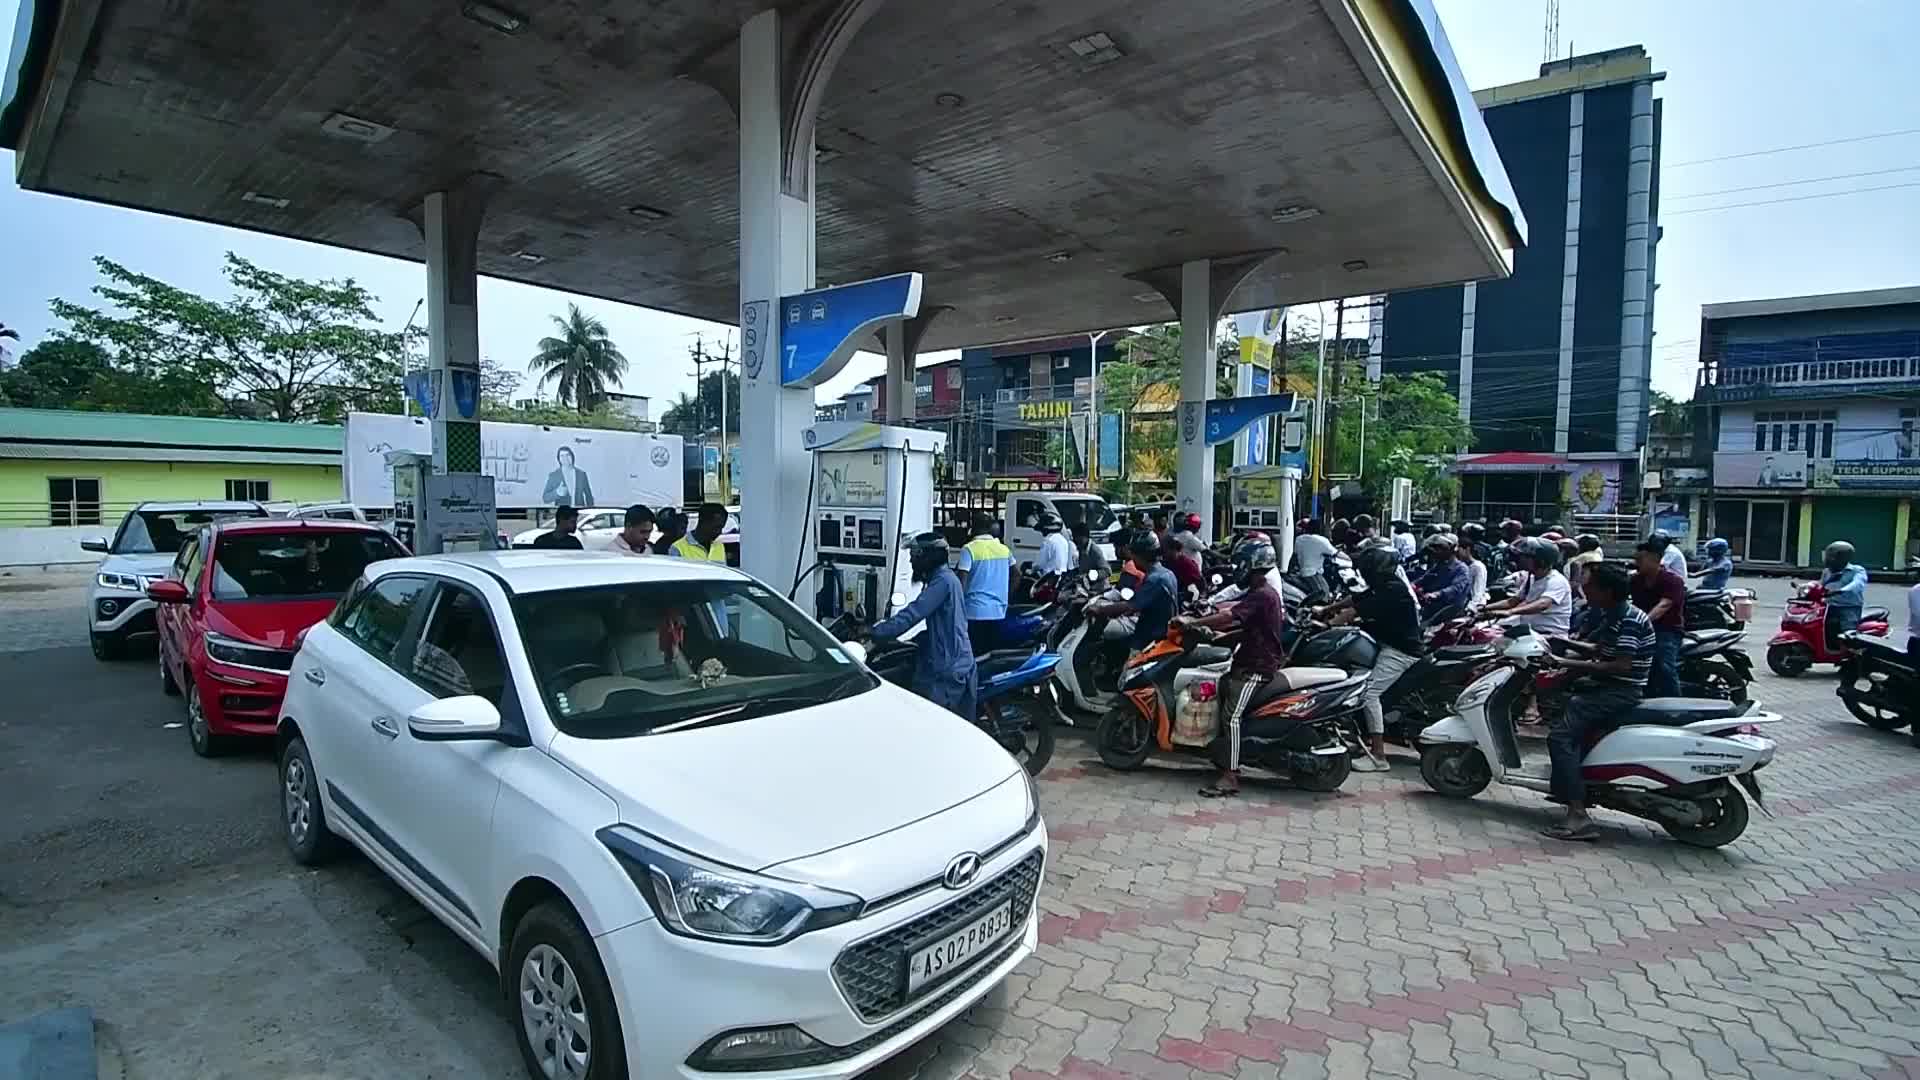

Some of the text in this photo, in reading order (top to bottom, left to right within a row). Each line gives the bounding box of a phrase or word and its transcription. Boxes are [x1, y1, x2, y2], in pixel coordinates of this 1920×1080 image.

[785, 344, 798, 369] 7
[1017, 400, 1073, 420] TAHINI
[1211, 422, 1220, 435] 3
[1838, 466, 1868, 474] TECH
